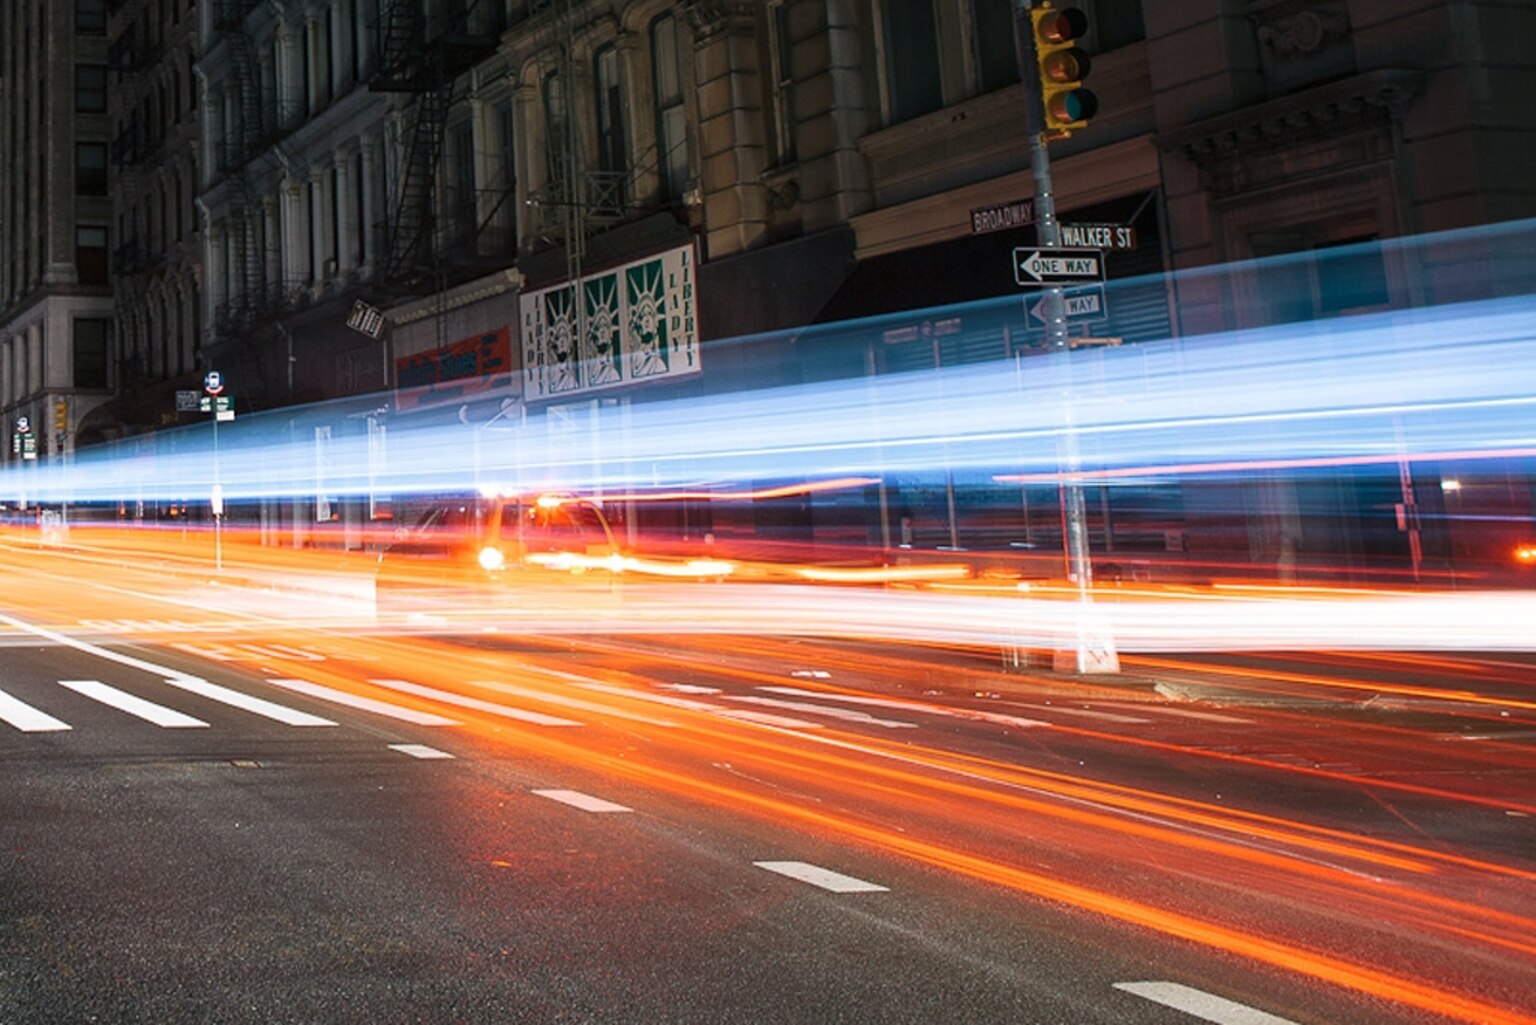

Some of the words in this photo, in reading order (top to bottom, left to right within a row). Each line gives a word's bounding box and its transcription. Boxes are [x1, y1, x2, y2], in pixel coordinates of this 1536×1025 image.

[973, 203, 1033, 232] BROADWAY
[1061, 226, 1113, 249] WALKER
[1116, 226, 1132, 249] ST
[1032, 259, 1059, 274] ONE
[1064, 259, 1092, 274] WAY
[669, 272, 681, 353] LADY
[681, 250, 695, 368] LIBERTY
[1069, 297, 1094, 313] WAY
[525, 313, 535, 382] LADY
[534, 295, 546, 395] LIBERTY
